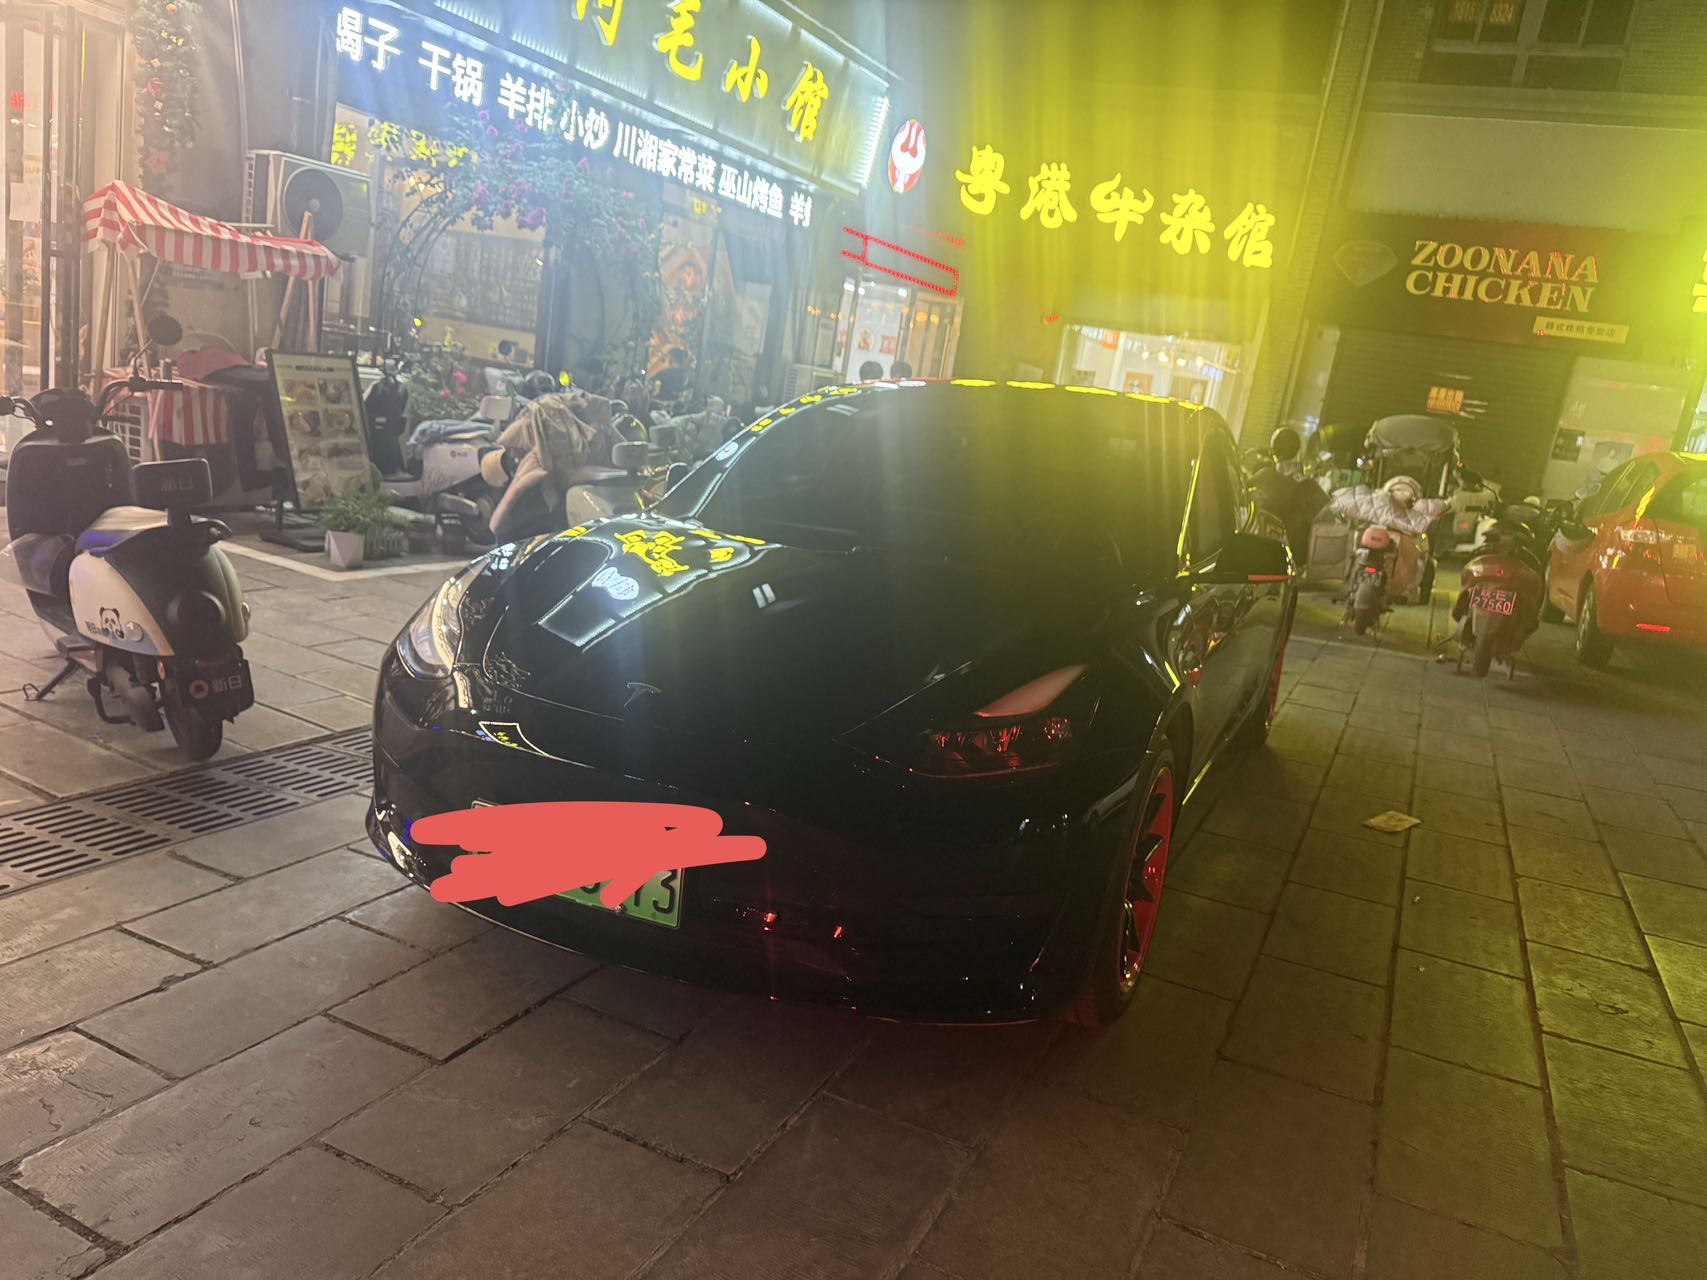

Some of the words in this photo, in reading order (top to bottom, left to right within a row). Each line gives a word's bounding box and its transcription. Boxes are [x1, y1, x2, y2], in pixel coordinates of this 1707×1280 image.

[417, 40, 485, 107] 干锅
[497, 71, 556, 132] 羊排
[559, 99, 611, 150] 小炒
[612, 120, 718, 194] 川湘家常菜
[717, 163, 785, 220] 巫山烤鱼
[954, 143, 1277, 270] 粤港牛杂馆
[1405, 269, 1596, 313] CHICKEN
[1410, 240, 1599, 284] ZOONANA
